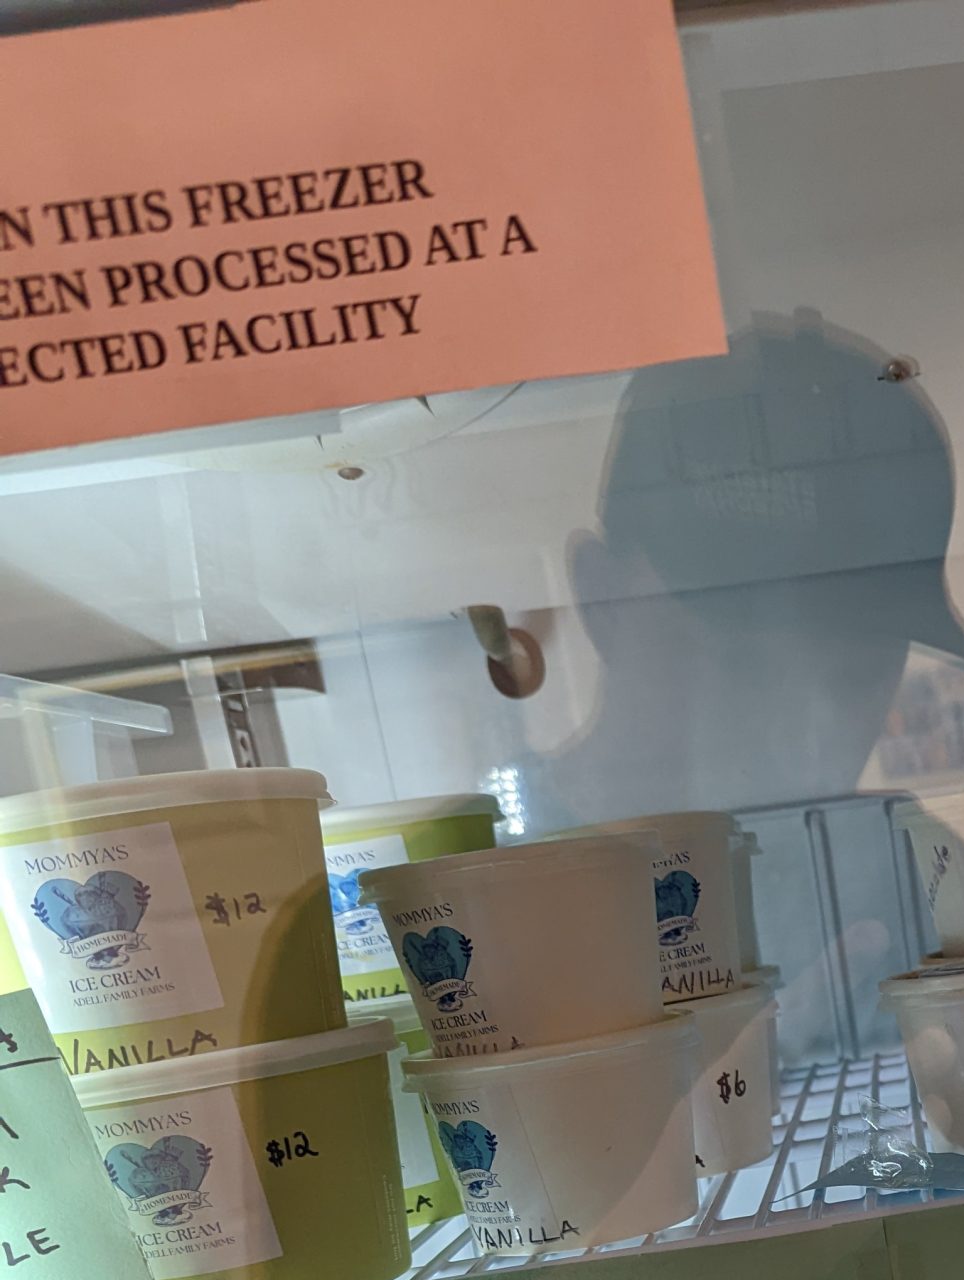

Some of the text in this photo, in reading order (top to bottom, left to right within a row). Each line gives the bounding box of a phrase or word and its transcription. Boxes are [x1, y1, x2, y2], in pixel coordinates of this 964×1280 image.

[43, 190, 173, 245] THIS
[181, 158, 434, 227] FREEZER
[100, 231, 412, 308] PROCESSED
[424, 218, 488, 266] AT
[499, 213, 538, 255] A
[177, 294, 423, 364] FACILITY
[24, 845, 129, 875] MOMMYA'S
[205, 892, 267, 927] $12
[76, 932, 129, 954] HOMEMADE
[667, 943, 705, 961] CREAM
[69, 966, 161, 994] ICE CREAM
[661, 968, 735, 994] ANILLA
[73, 982, 176, 1008] ADELL FAMILY FARMS
[431, 1010, 487, 1031] ICE CREAM
[57, 1029, 217, 1075] VANILLA
[717, 1070, 747, 1104] $6
[94, 1111, 192, 1140] MOMMYA'S
[265, 1131, 319, 1168] $12
[144, 1193, 192, 1211] HOMEMADE
[478, 1201, 510, 1213] CREAM
[137, 1222, 222, 1248] ICE CREAM
[143, 1236, 236, 1258] DELL FAMILY FARMS
[472, 1220, 580, 1250] VANILLA
